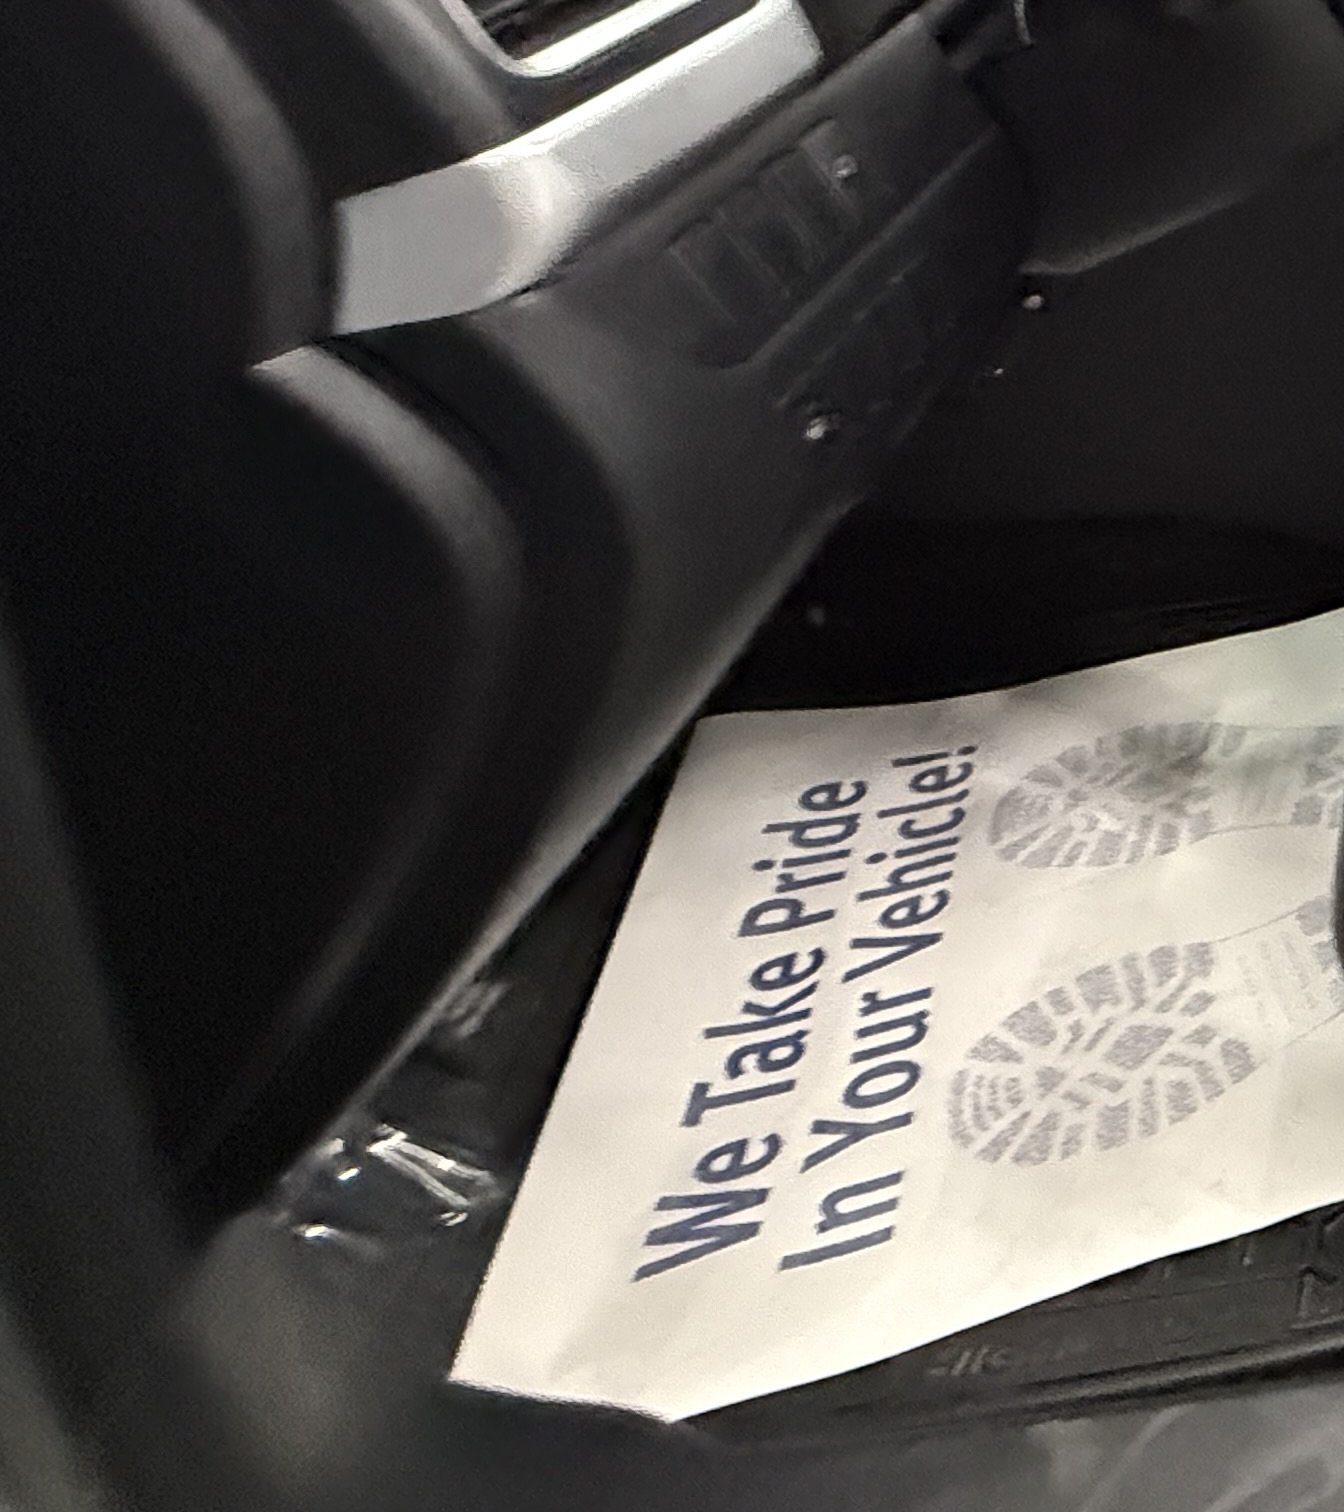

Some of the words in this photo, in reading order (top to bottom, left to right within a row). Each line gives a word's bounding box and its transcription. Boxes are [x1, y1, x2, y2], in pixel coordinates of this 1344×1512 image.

[736, 778, 870, 939] Pride
[841, 745, 978, 984] Vehicle!
[680, 945, 828, 1129] Take
[800, 986, 933, 1174] Your
[632, 1132, 783, 1283] We
[779, 1170, 904, 1272] In
